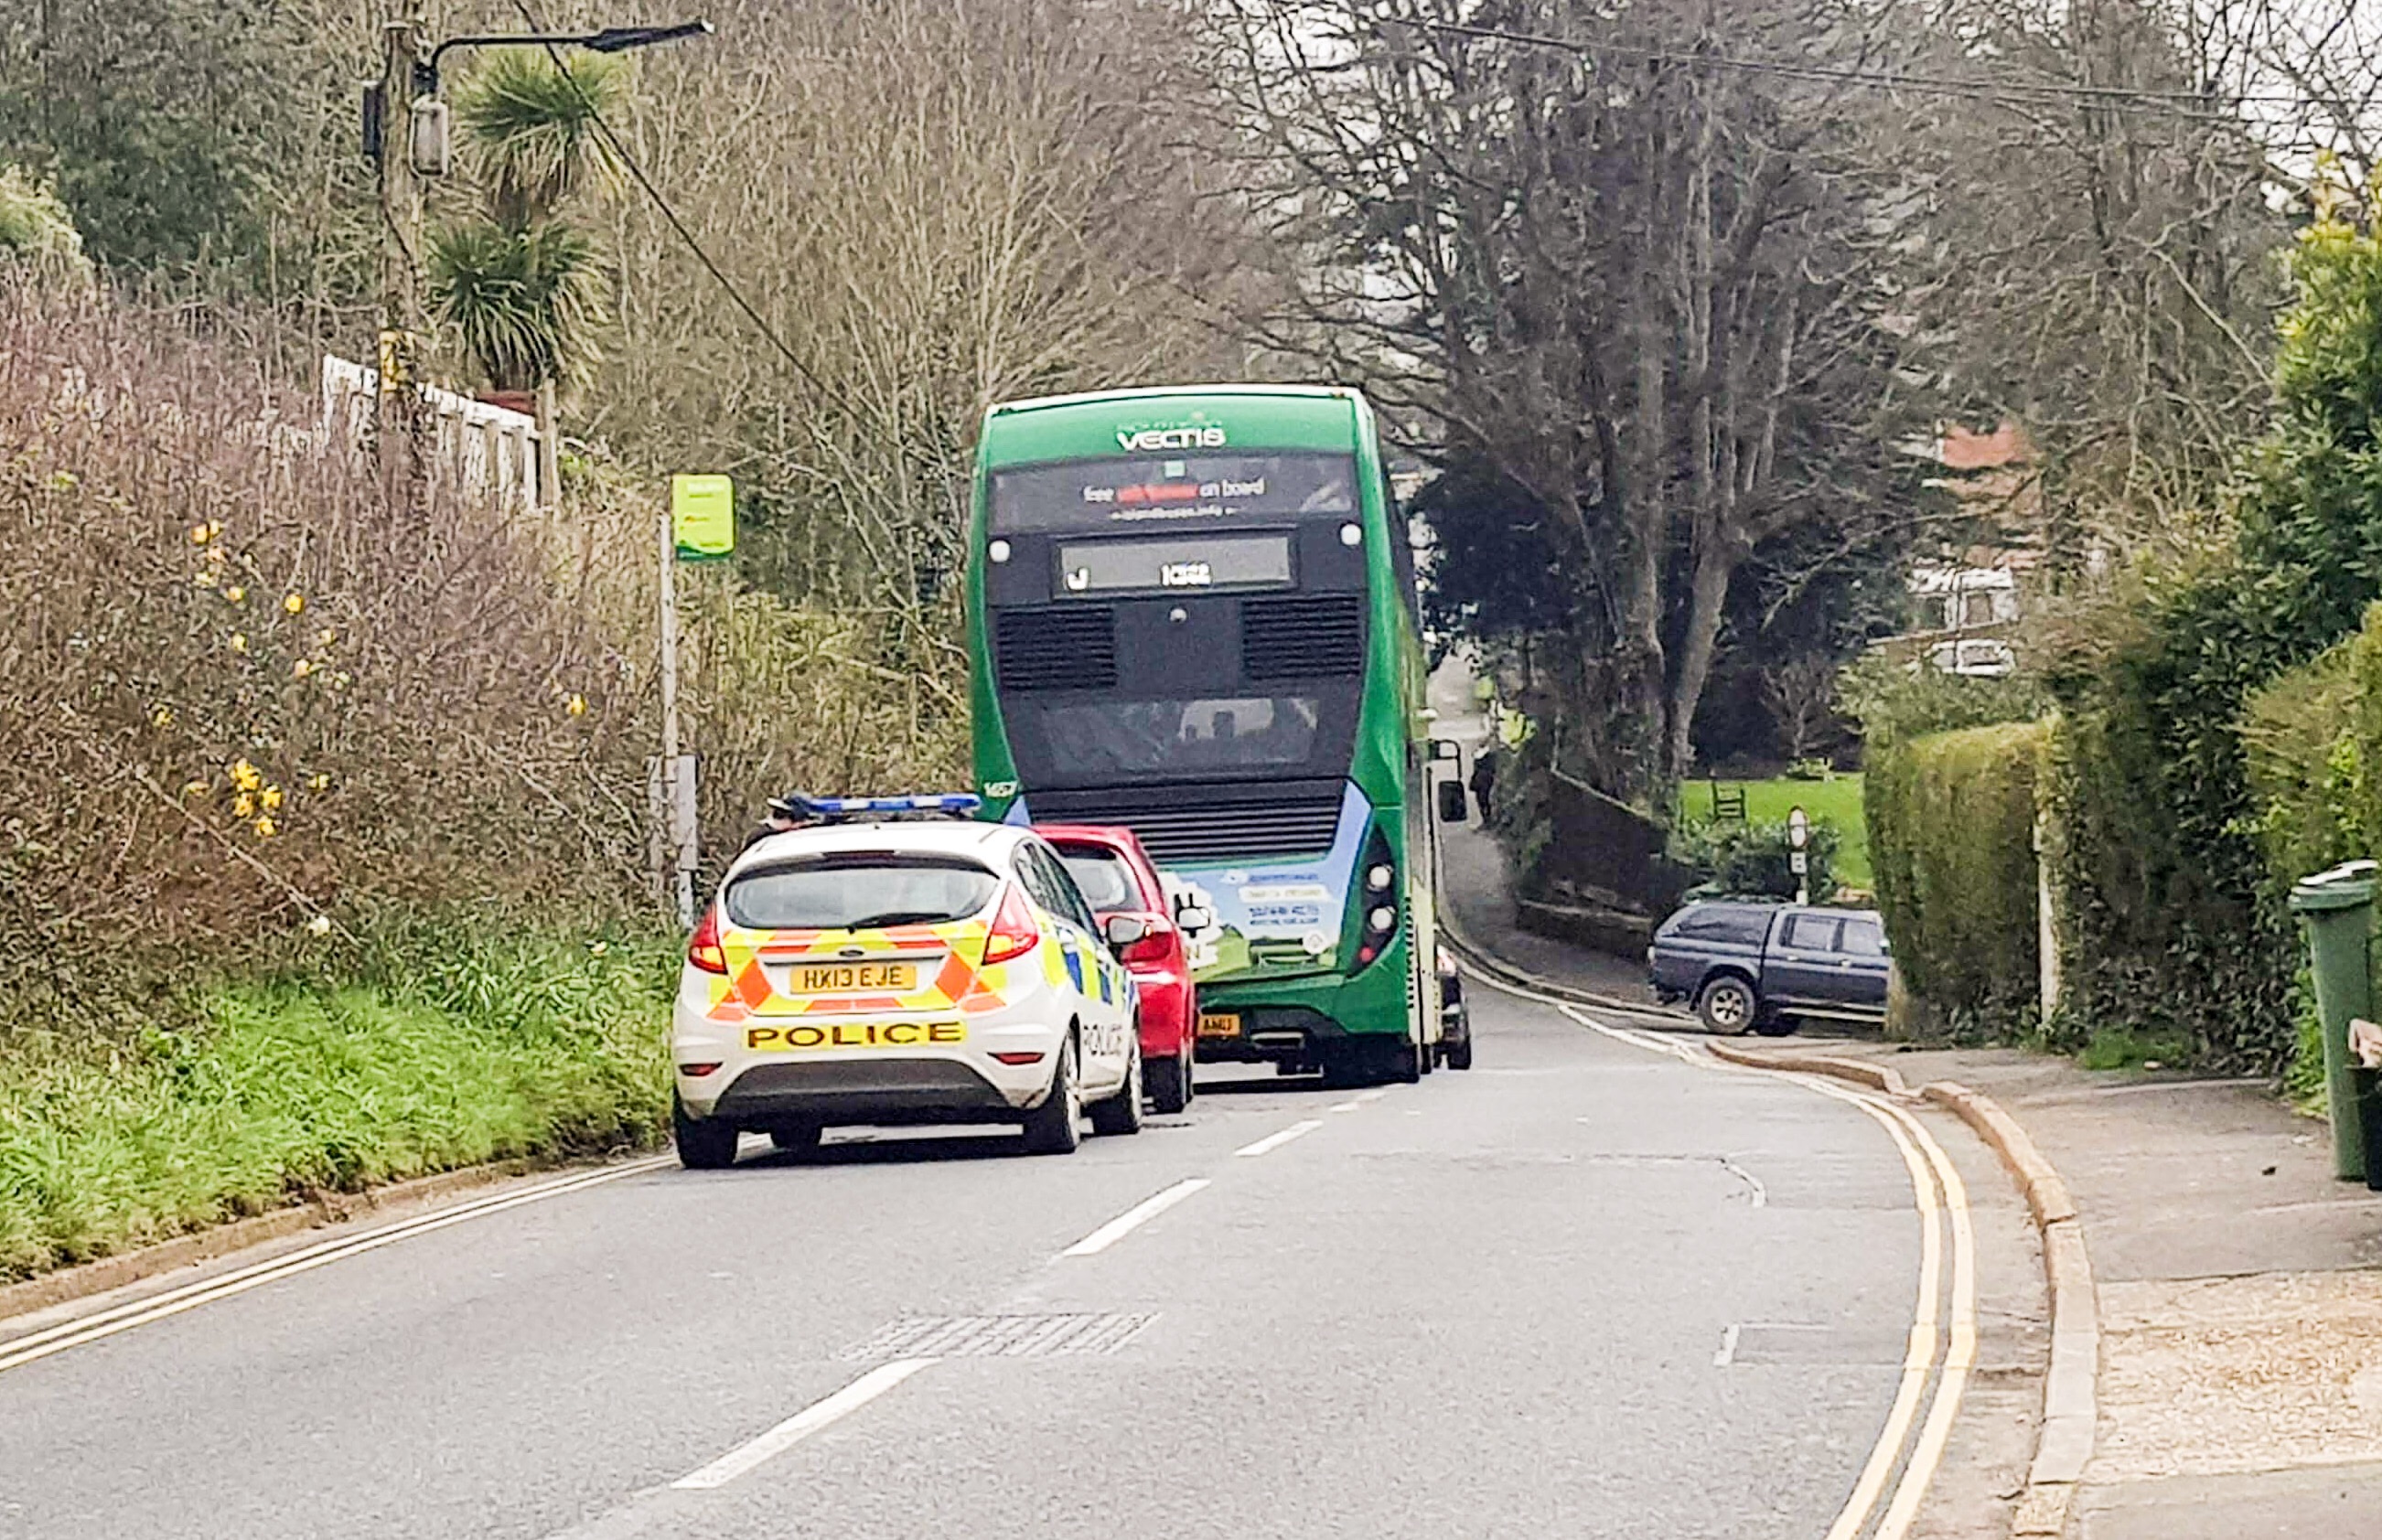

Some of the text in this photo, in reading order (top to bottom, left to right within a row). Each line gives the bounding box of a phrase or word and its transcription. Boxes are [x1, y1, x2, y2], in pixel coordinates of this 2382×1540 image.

[1116, 428, 1227, 452] VECTIS
[1222, 476, 1266, 497] board
[803, 965, 904, 989] HX13 EJE
[747, 1021, 961, 1049] POLICE
